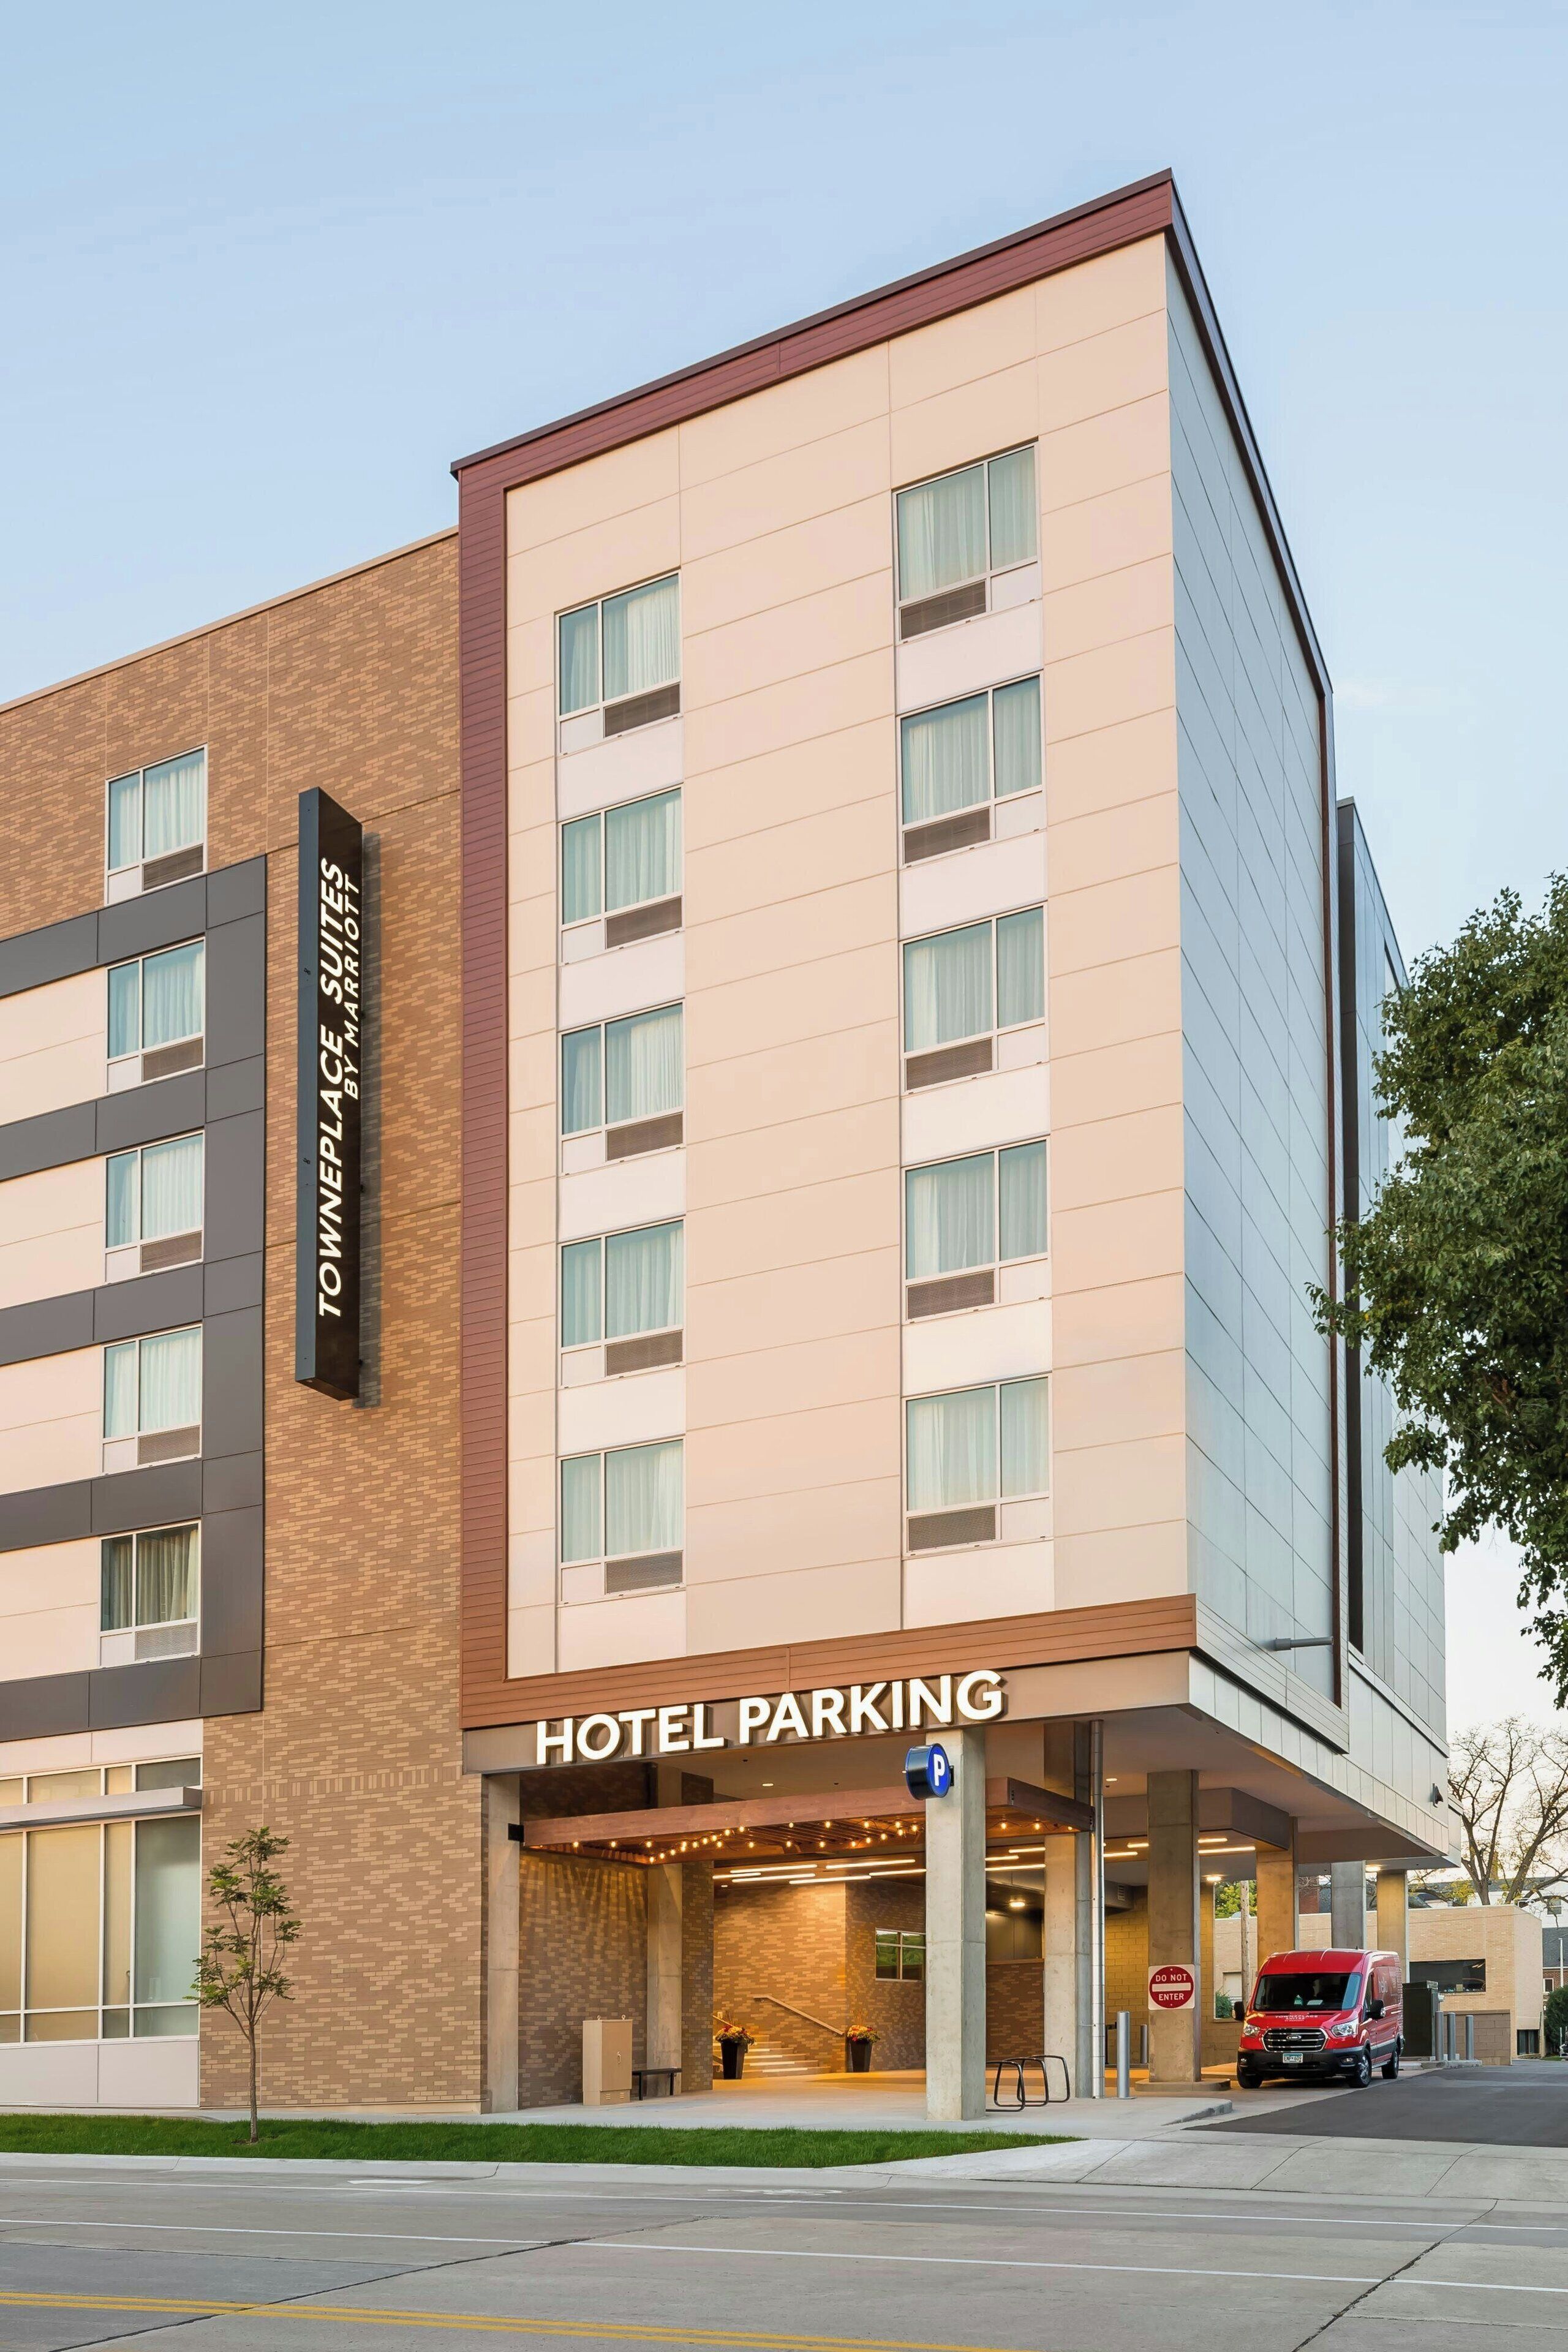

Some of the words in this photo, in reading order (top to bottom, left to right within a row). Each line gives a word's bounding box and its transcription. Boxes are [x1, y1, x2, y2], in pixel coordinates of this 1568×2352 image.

[320, 858, 343, 1005] SUITES
[344, 873, 360, 1047] MARRIOTT
[344, 1054, 359, 1100] BY
[318, 1024, 343, 1317] TOWNEPLACE
[536, 1703, 725, 1765] HOTEL
[739, 1670, 1003, 1744] PARKING
[933, 1754, 945, 1787] P
